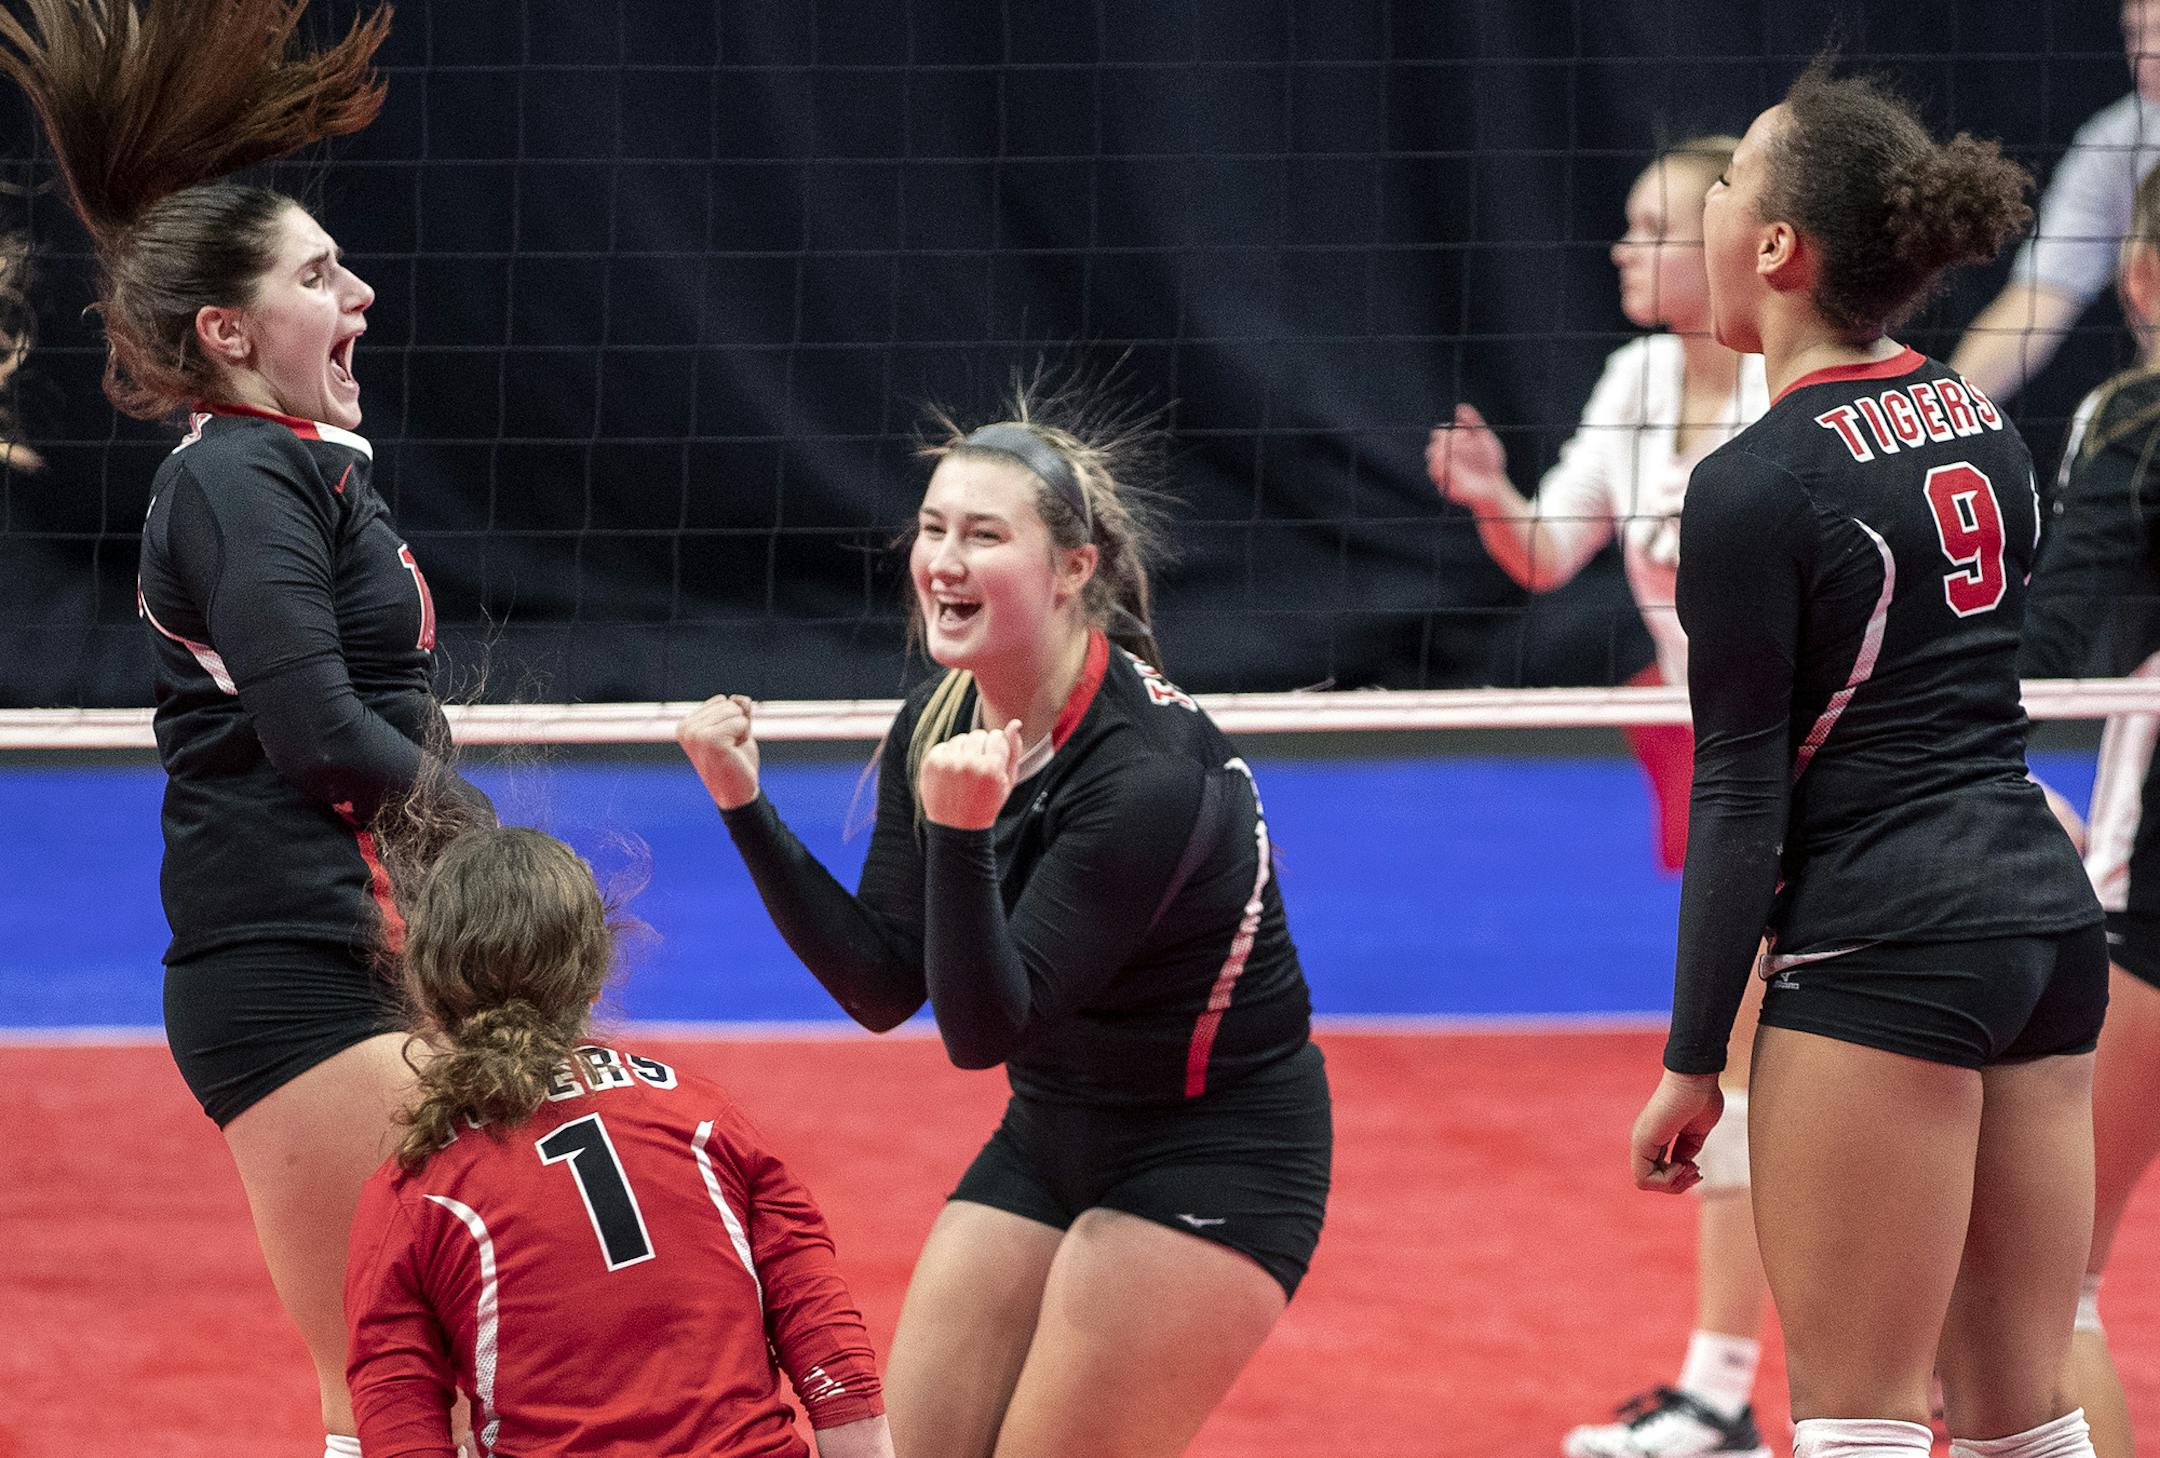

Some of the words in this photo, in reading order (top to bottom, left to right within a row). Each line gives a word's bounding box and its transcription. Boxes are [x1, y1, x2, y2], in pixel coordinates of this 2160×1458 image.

[1815, 376, 2003, 463] TIGERS
[1924, 461, 2007, 618] 9
[534, 1112, 656, 1272] 1
